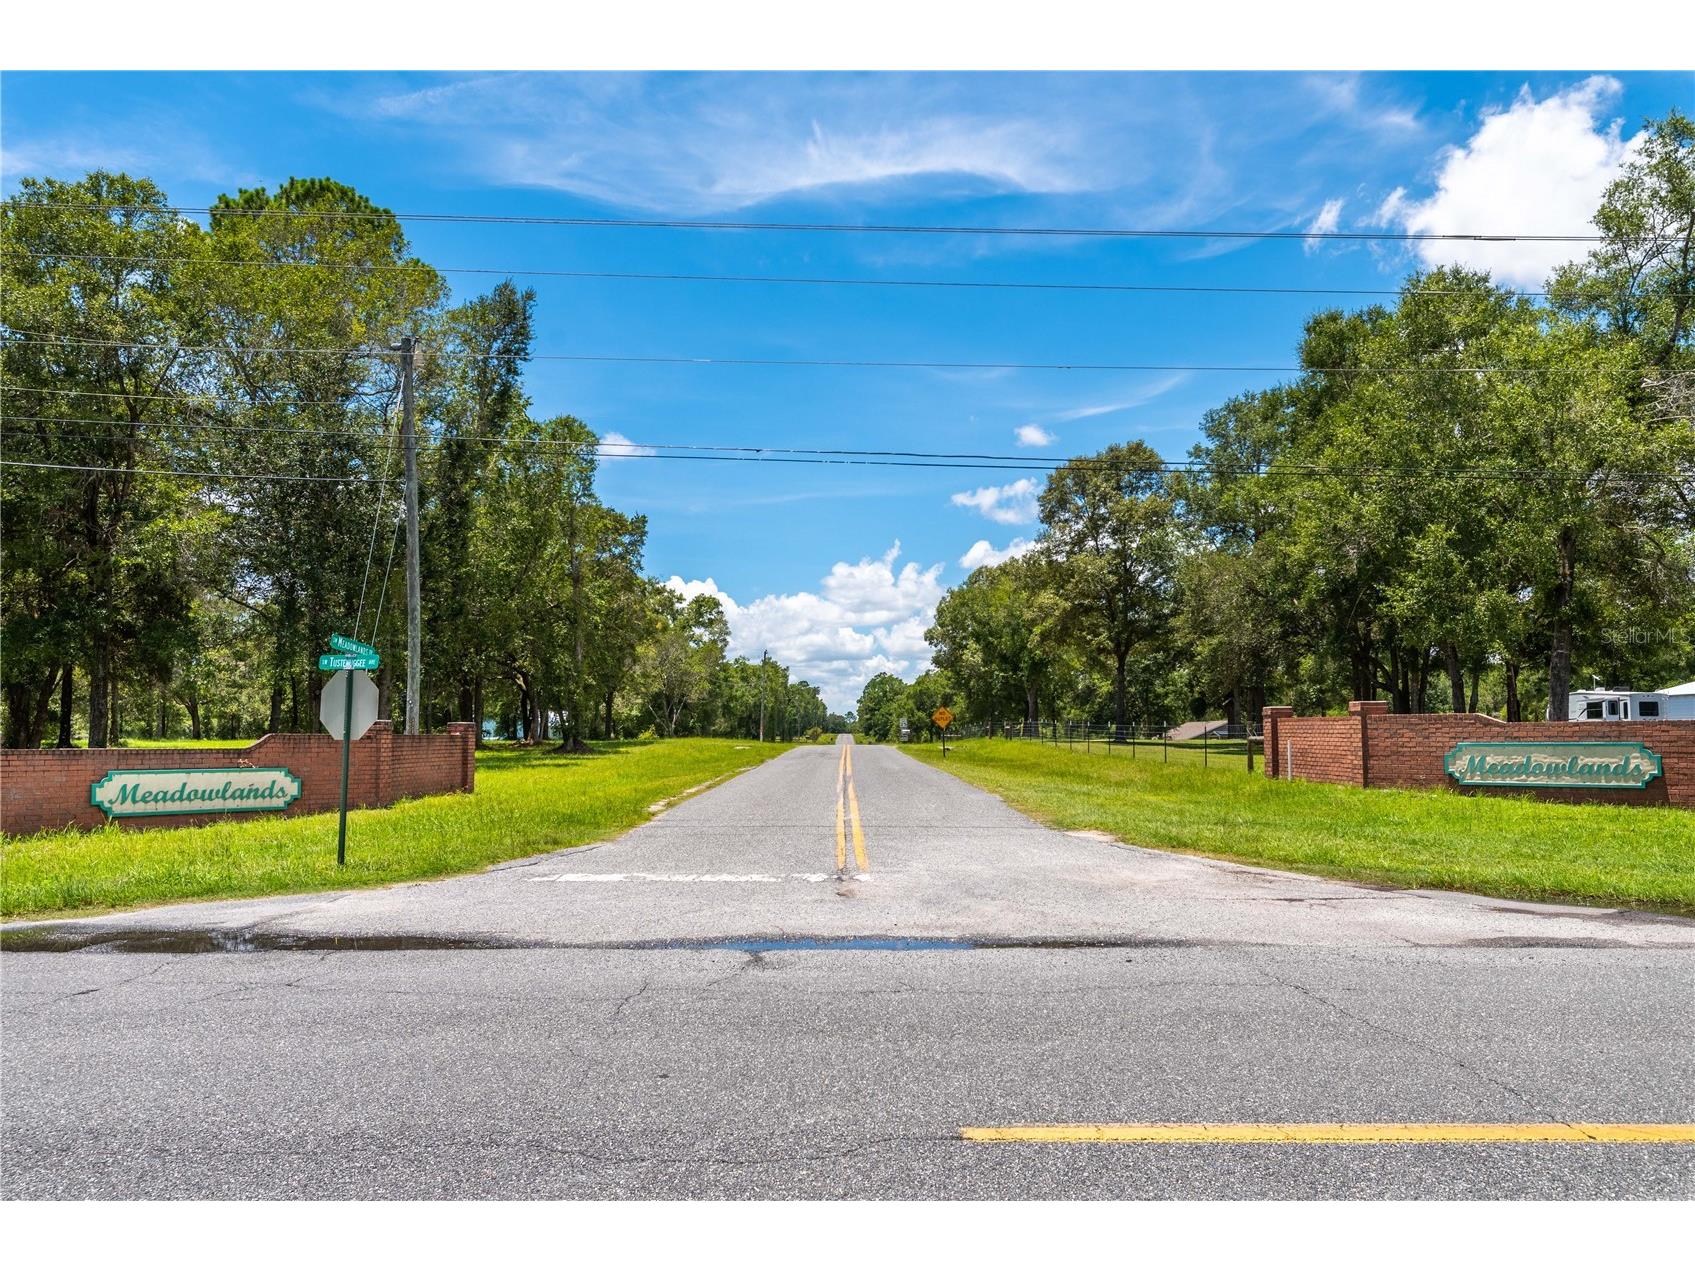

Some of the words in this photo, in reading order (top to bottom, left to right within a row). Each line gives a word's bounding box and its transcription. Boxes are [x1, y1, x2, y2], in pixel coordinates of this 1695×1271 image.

[337, 636, 369, 656] MEADOWLANDS
[1458, 754, 1644, 777] Meadowlands
[108, 779, 288, 806] Meadowlands
